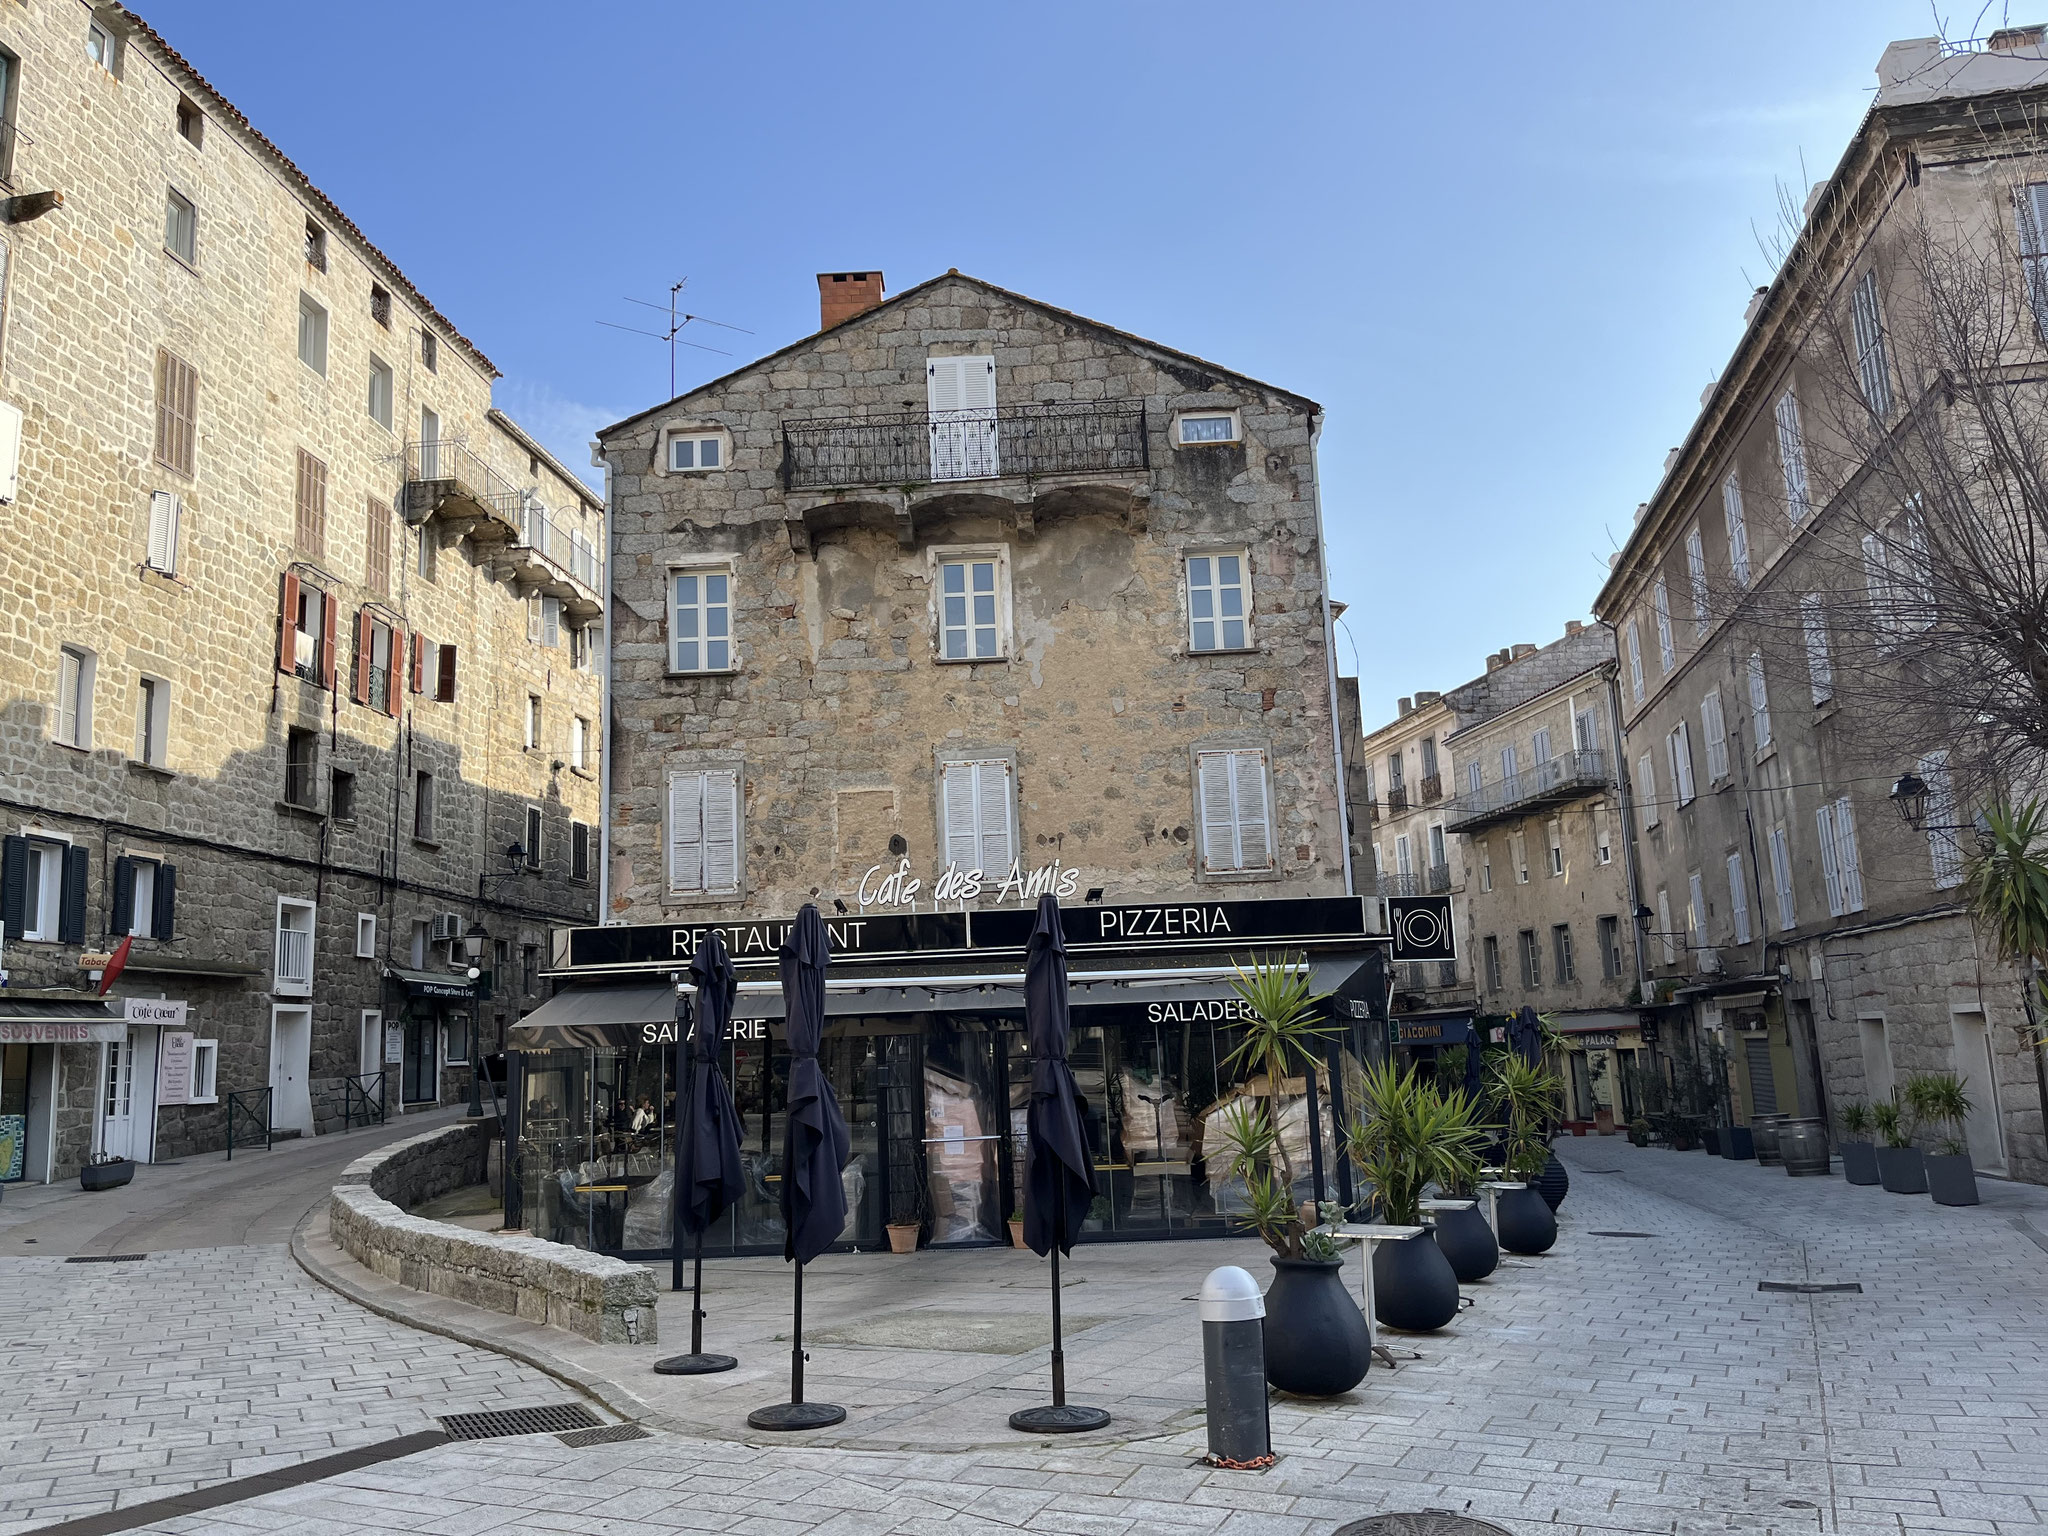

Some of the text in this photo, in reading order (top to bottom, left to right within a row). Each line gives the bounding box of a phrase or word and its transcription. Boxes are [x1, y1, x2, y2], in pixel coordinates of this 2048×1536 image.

[858, 856, 1080, 906] Cafe des Amis
[1100, 906, 1232, 937] PIZZERIA
[672, 922, 867, 956] RESTAUNT
[80, 956, 107, 967] Tabac
[423, 985, 433, 993] POP
[1148, 1000, 1266, 1023] SALADER
[1, 1024, 89, 1040] SOUVENIRS
[643, 1019, 766, 1043] SALRIE
[1399, 1025, 1442, 1039] GIACOMINI
[1585, 1035, 1615, 1046] PALACE
